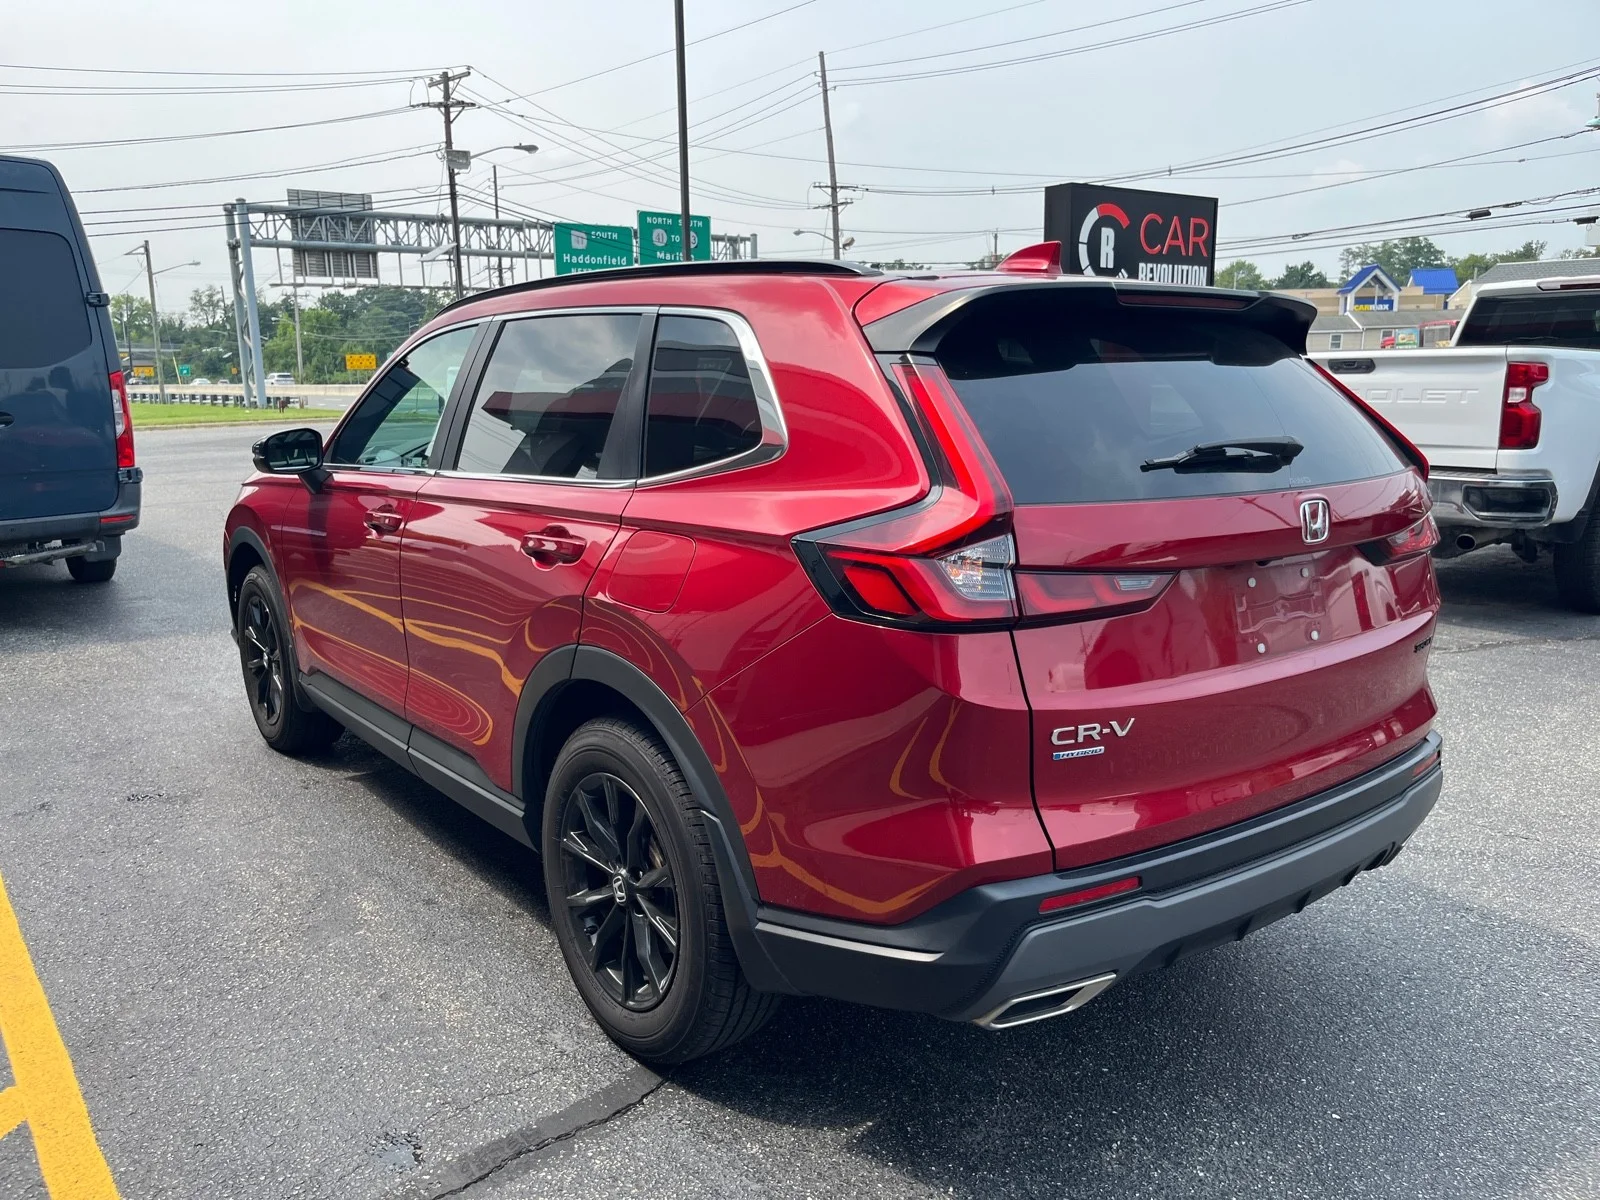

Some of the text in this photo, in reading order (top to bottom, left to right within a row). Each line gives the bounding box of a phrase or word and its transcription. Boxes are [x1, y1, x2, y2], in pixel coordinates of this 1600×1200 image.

[646, 216, 703, 228] NORTH SUTH
[591, 231, 618, 240] SOUTH
[655, 232, 664, 242] 41
[1139, 213, 1209, 257] CAR
[563, 253, 627, 265] Haddonfield
[656, 251, 695, 261] Marltn
[1138, 262, 1208, 286] REVOLUTION
[1352, 388, 1479, 404] OLET
[1051, 717, 1135, 746] CR-V
[1061, 748, 1103, 759] HYBRID
